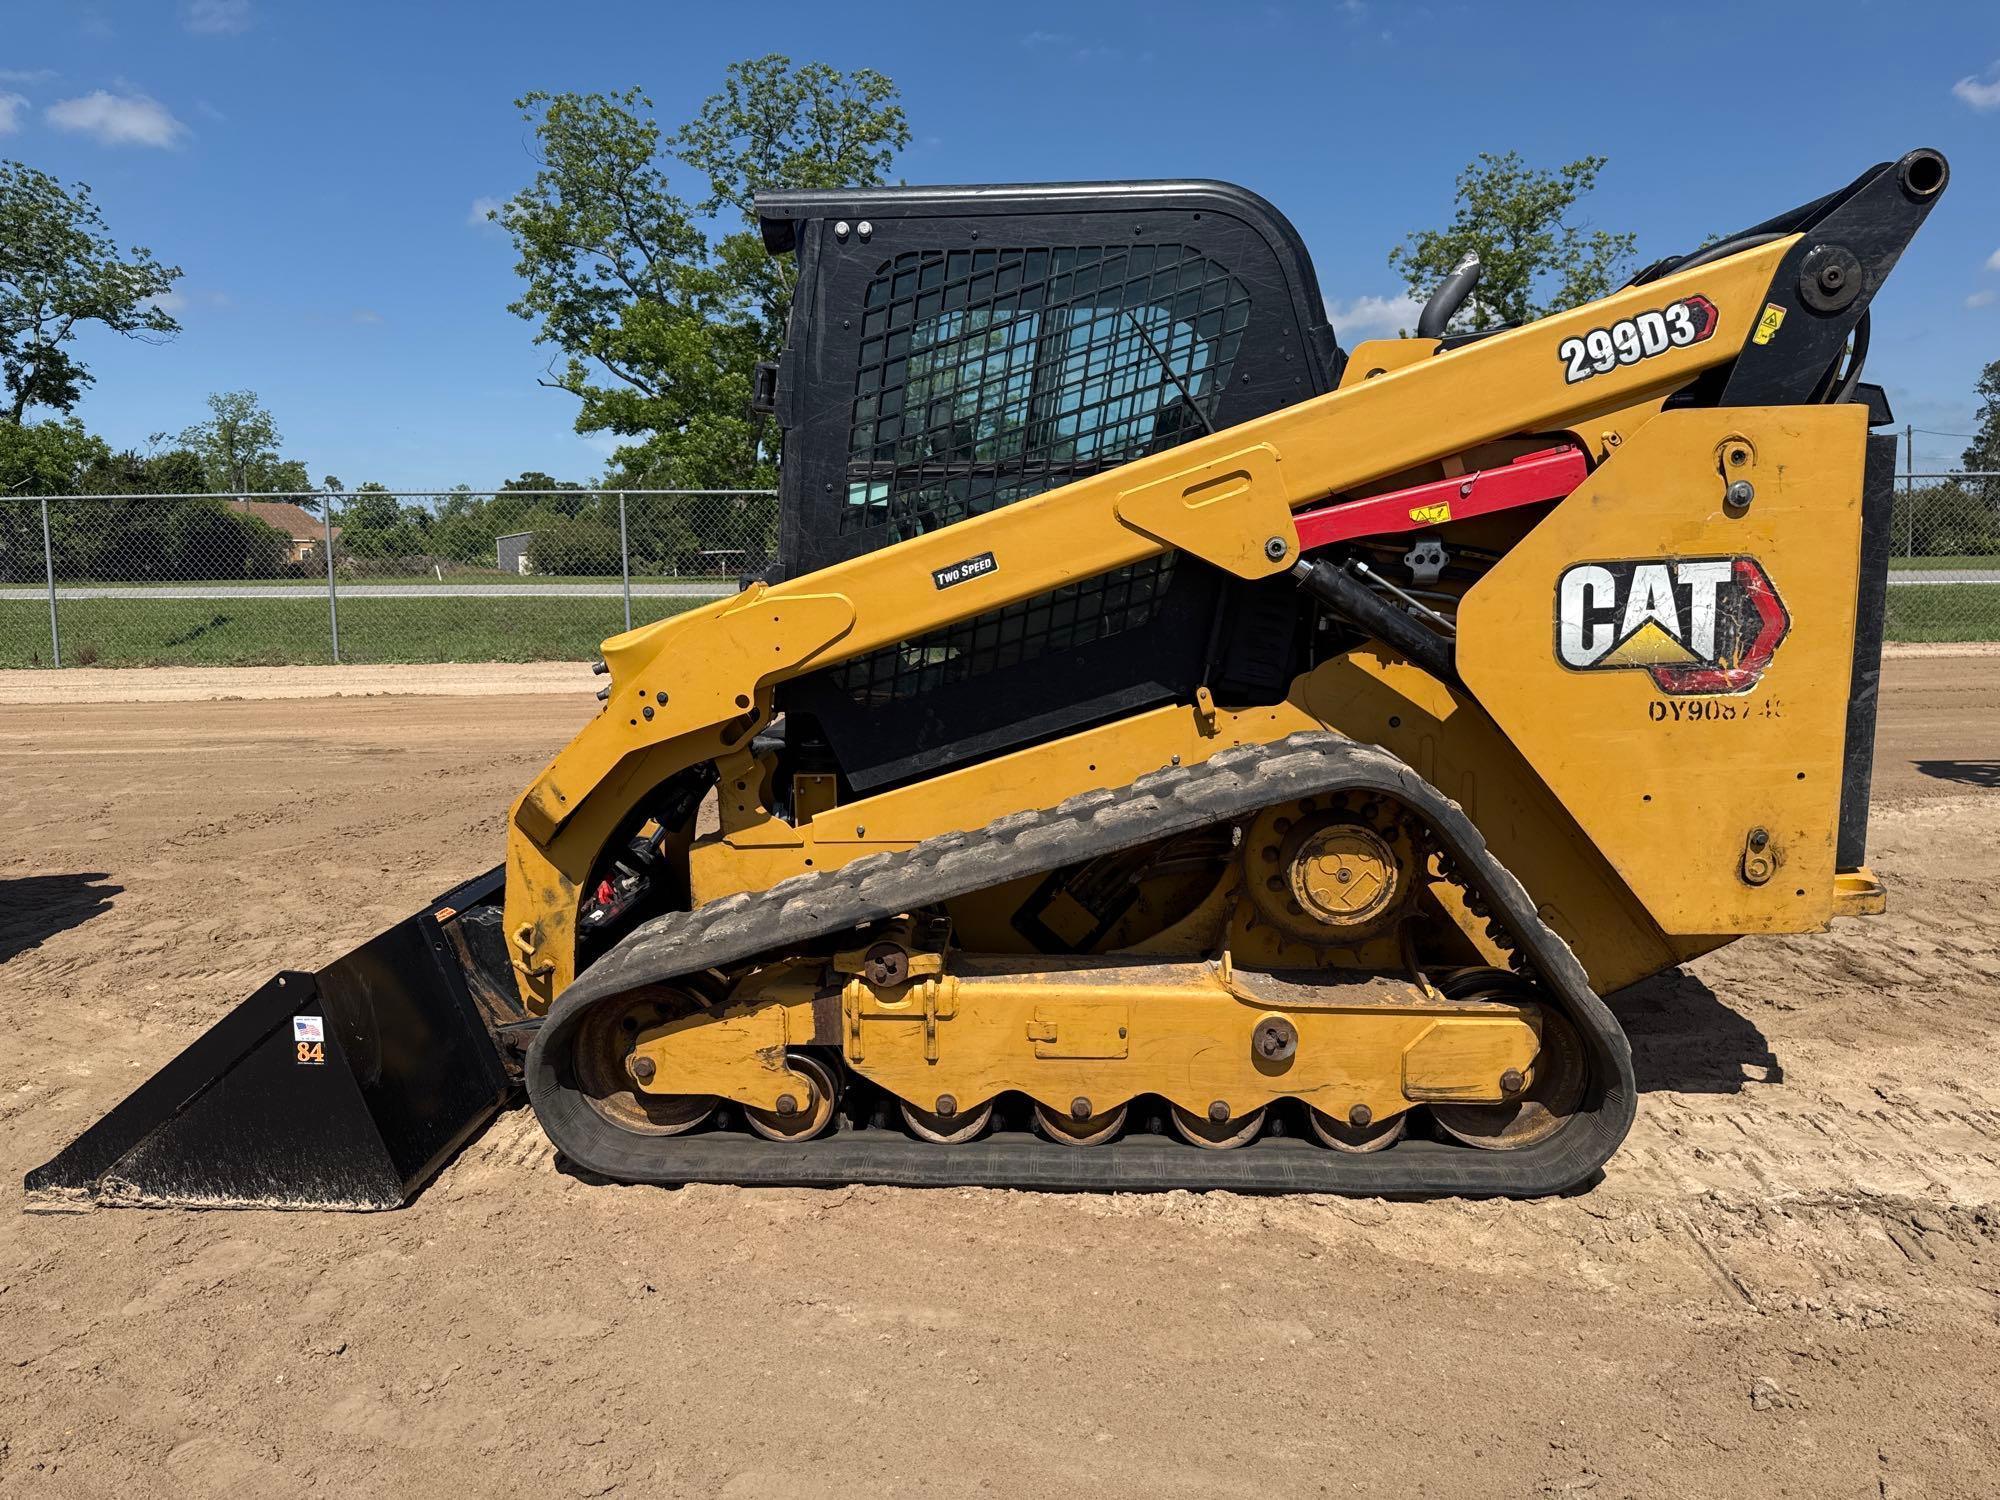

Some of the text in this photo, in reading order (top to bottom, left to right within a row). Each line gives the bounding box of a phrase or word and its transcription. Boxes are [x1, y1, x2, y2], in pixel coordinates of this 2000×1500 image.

[1560, 303, 1696, 382] 299D3
[1560, 561, 1732, 666] CAT
[297, 1041, 325, 1062] 84
